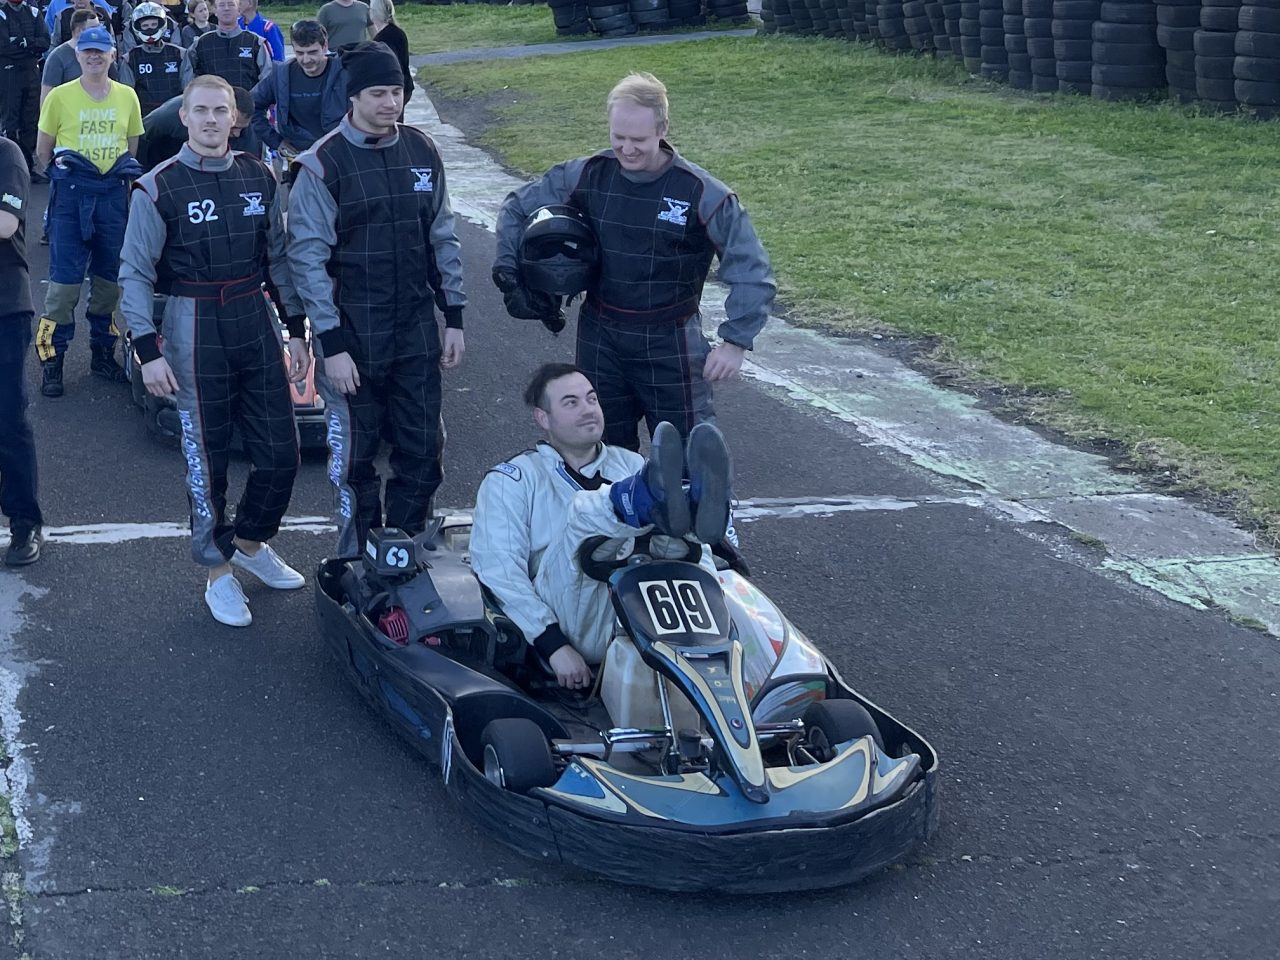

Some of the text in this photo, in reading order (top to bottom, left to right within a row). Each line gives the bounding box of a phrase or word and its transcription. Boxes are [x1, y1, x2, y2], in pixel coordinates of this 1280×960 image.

[138, 63, 153, 74] 50
[79, 107, 117, 121] MOVE
[80, 120, 117, 135] FAST
[78, 135, 119, 148] THINK
[187, 198, 219, 224] 52
[179, 410, 203, 486] WOLLONGONG
[339, 487, 352, 519] ARTS
[385, 545, 410, 568] 69
[646, 582, 713, 631] 69
